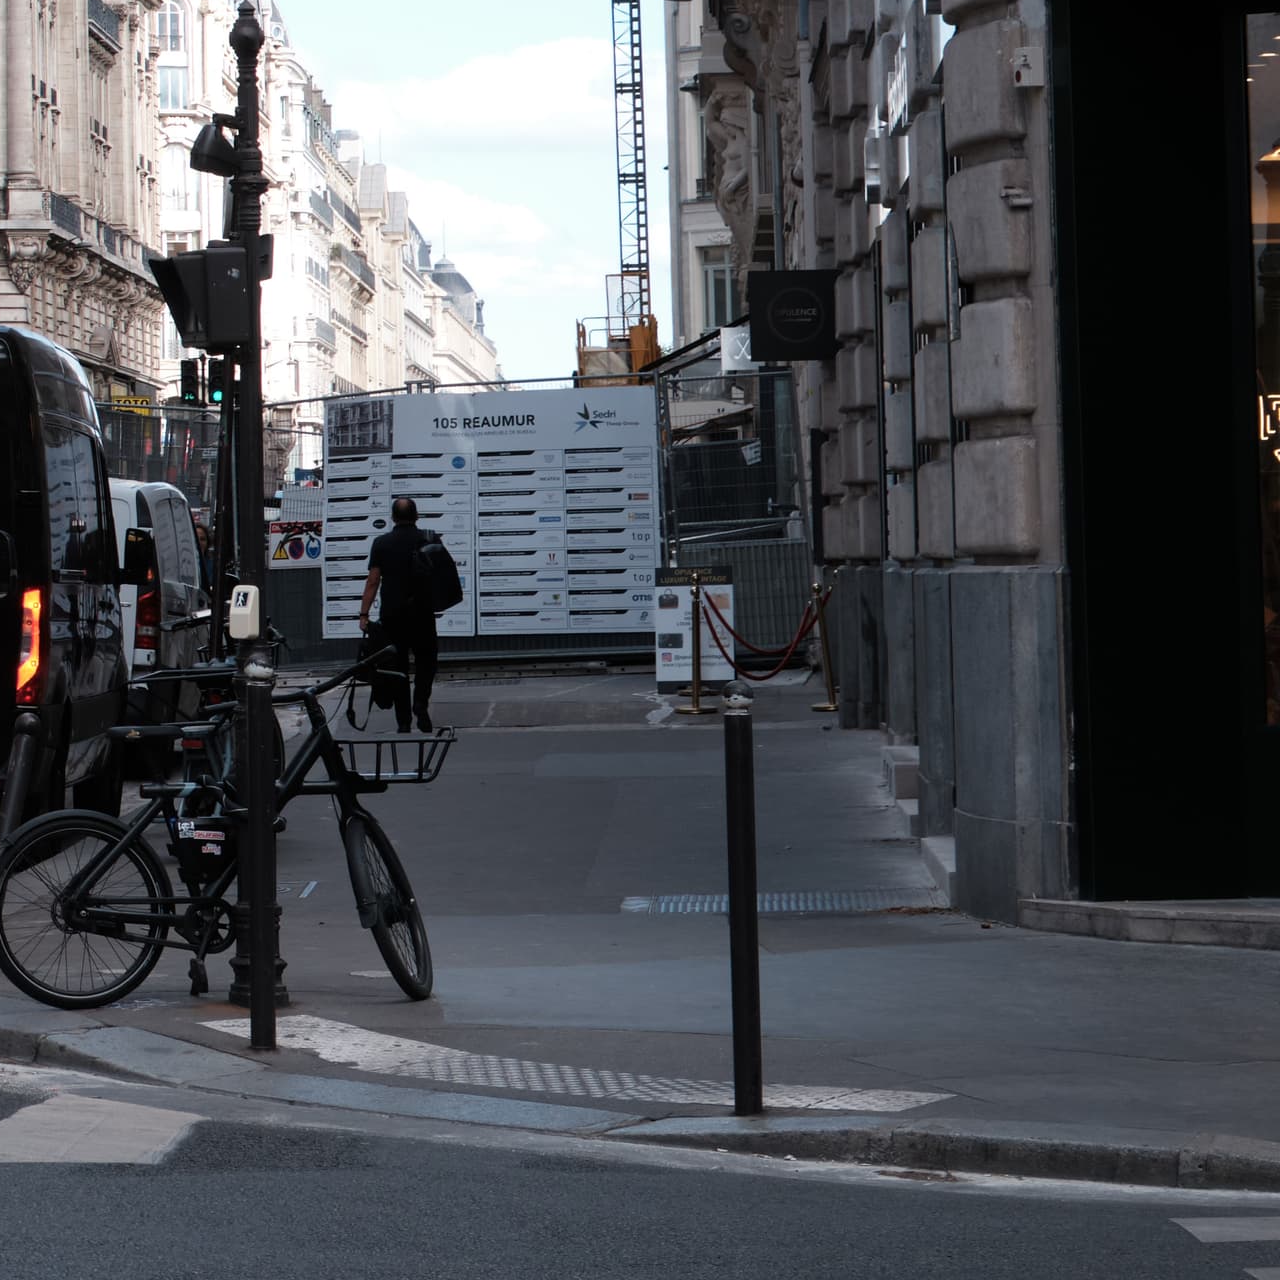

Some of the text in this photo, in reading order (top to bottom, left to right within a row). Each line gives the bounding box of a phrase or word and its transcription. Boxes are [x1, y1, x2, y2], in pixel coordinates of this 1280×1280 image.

[776, 307, 816, 317] ULENCE
[592, 409, 616, 420] Sedri
[433, 414, 535, 430] 105 REAUMUR
[632, 531, 651, 542] top
[633, 573, 652, 583] top
[698, 575, 728, 583] INTAGE
